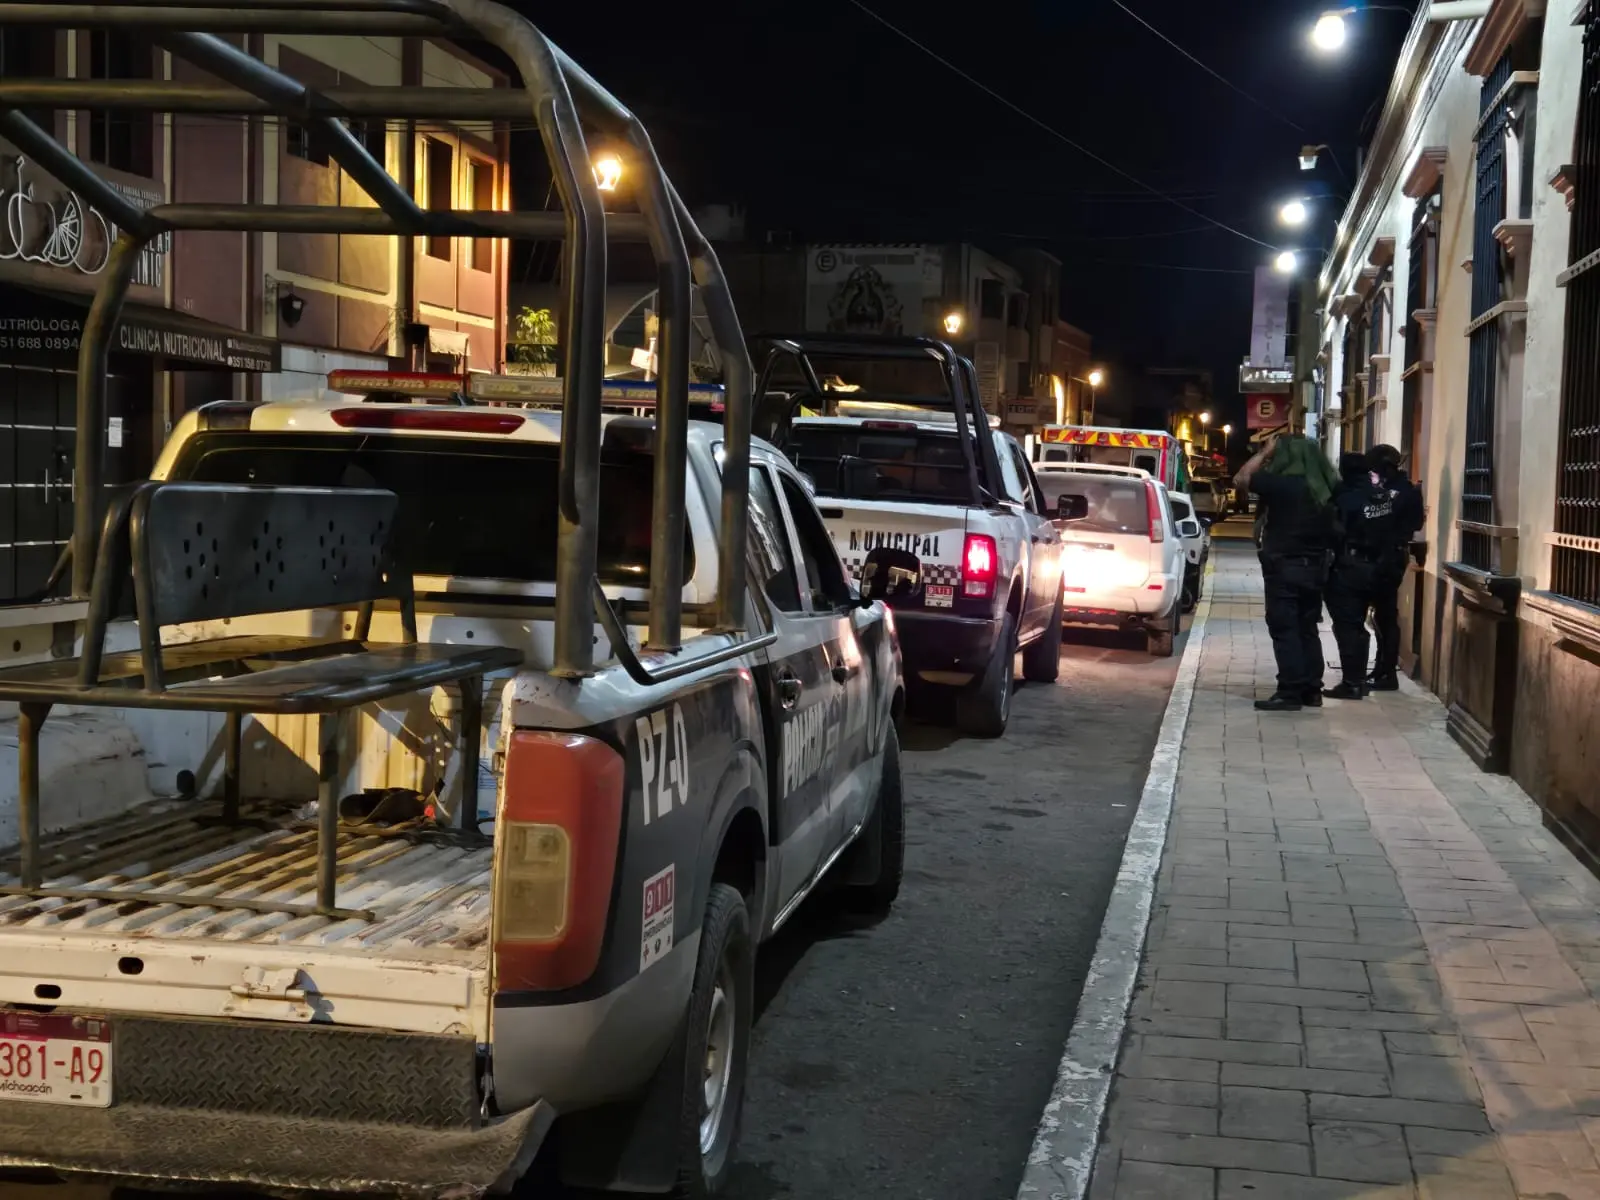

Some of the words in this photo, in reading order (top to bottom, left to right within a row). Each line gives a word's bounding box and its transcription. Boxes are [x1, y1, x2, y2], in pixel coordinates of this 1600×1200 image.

[128, 249, 162, 288] INIC
[17, 336, 41, 349] 688
[45, 337, 80, 350] 0894
[120, 326, 162, 353] CLINICA
[163, 333, 226, 362] NUTRICIONAL
[849, 529, 940, 557] MUNICIPAL
[646, 875, 673, 917] 911
